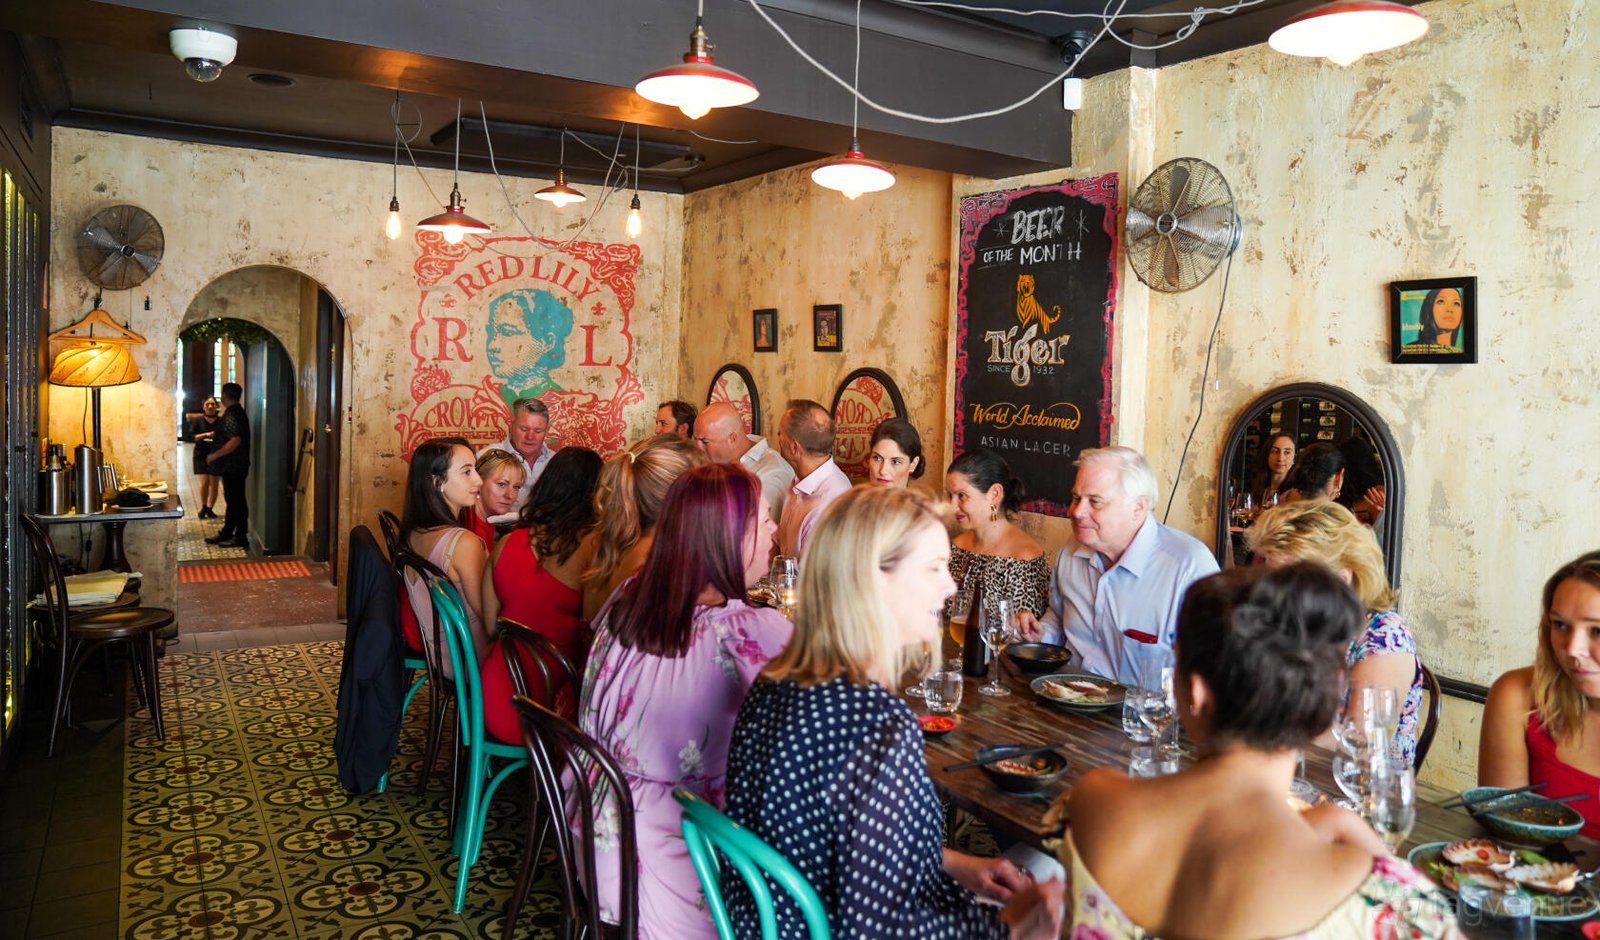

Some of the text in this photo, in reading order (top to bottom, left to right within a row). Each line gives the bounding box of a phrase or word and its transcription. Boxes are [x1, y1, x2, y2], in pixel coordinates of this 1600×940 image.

[1011, 206, 1065, 244] BEER
[983, 241, 1082, 265] OF THE MONTH
[454, 255, 601, 303] RED LILY
[432, 317, 613, 367] R L
[984, 323, 1071, 387] Tiger
[987, 365, 1054, 375] SINCE 1932
[969, 402, 1081, 430] World Acclaimed
[981, 435, 1018, 449] ASIAN
